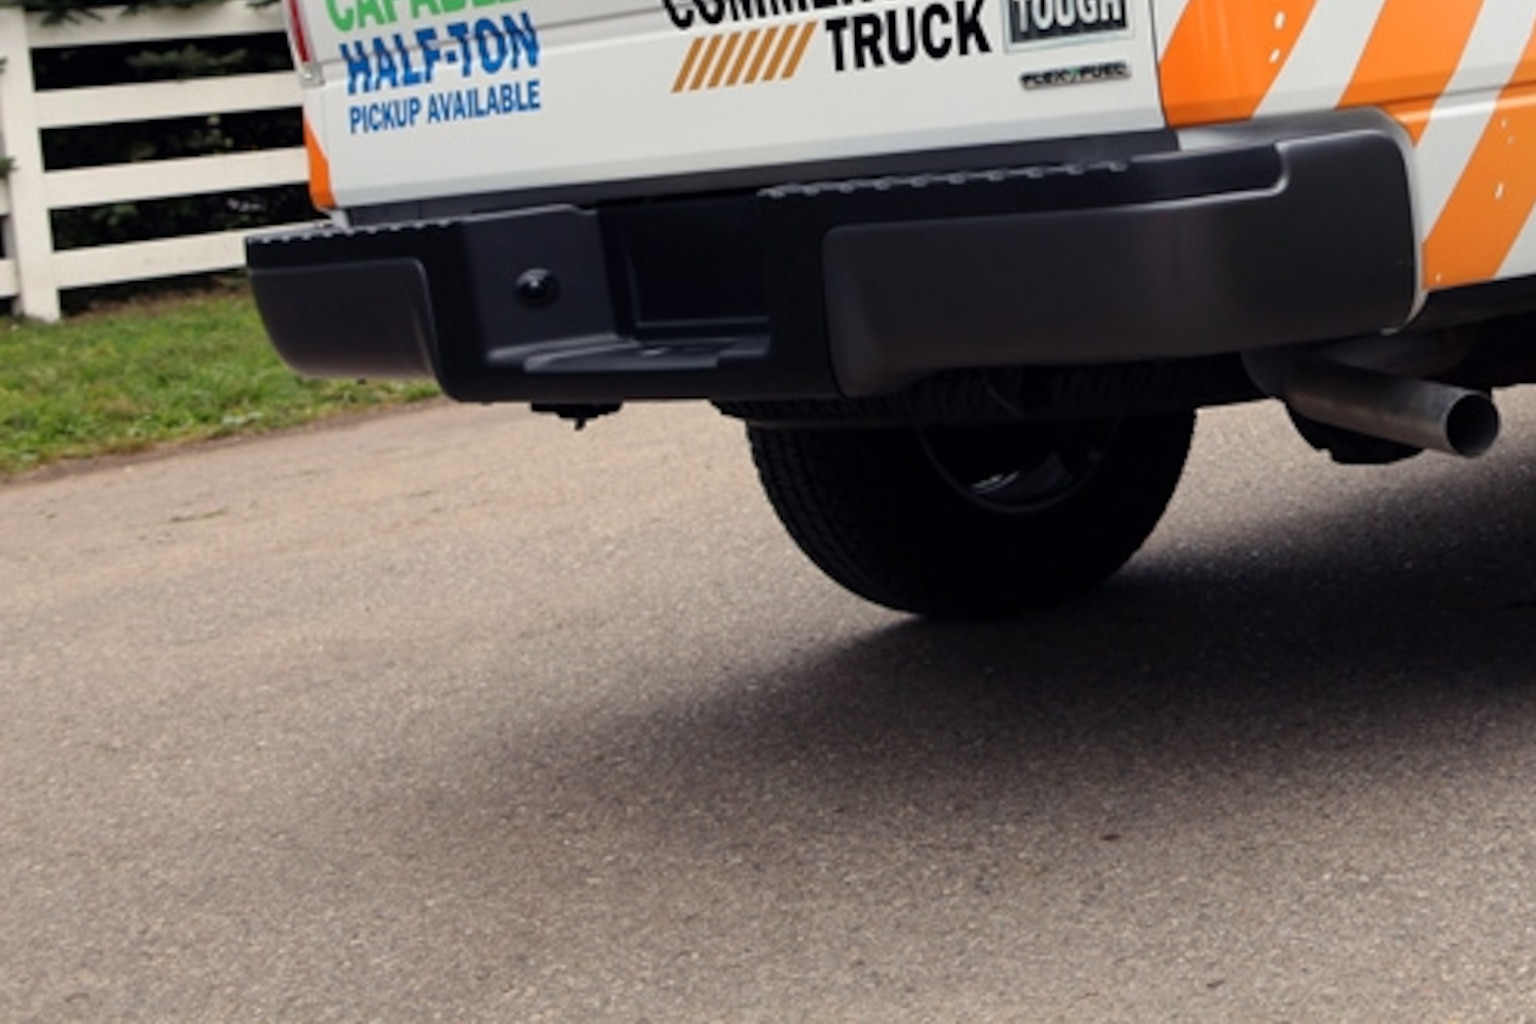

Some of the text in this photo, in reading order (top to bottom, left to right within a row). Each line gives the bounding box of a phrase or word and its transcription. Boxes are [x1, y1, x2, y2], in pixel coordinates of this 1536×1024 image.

[339, 10, 541, 96] HALF-TON
[349, 79, 541, 135] PICKUP AVAILABLE
